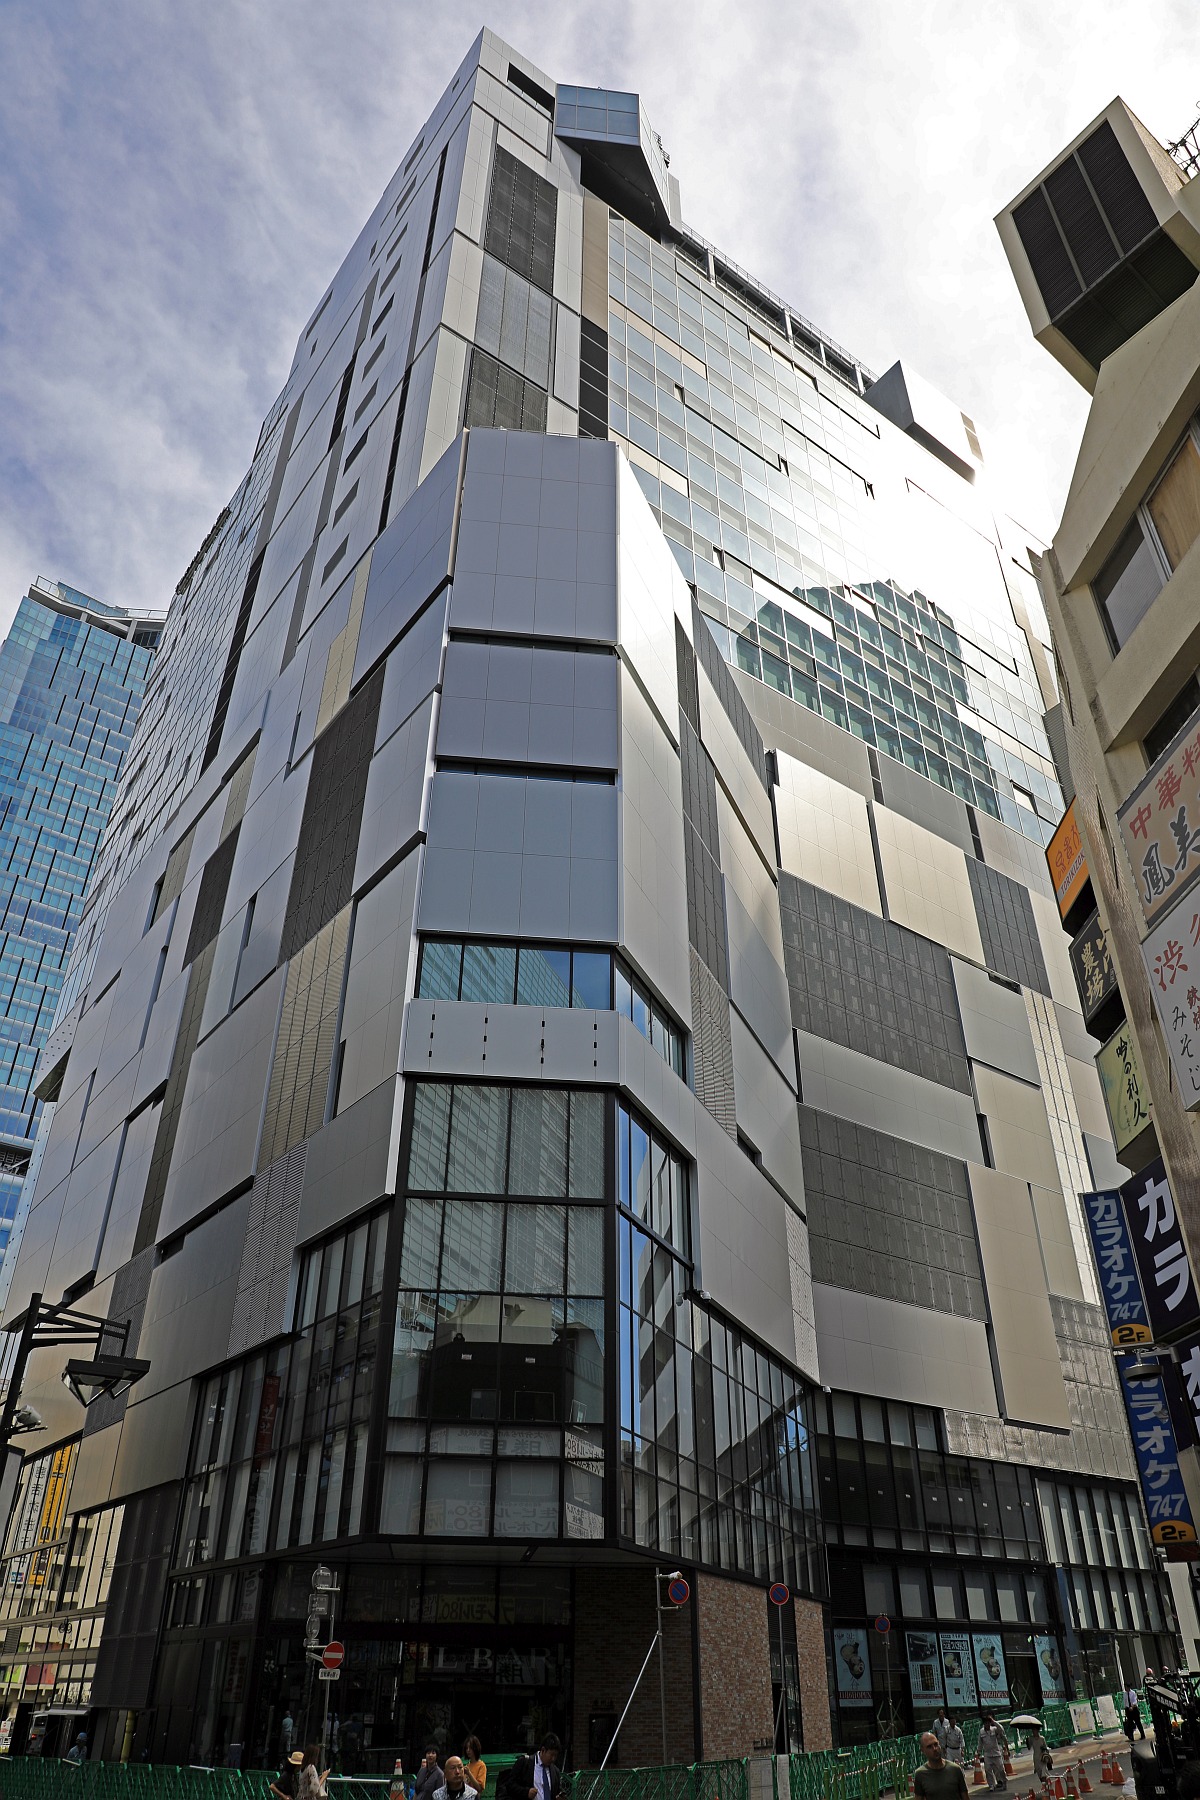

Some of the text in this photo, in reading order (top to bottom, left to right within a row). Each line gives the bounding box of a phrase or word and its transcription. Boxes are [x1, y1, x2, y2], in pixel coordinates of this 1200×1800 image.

[1115, 1035, 1148, 1127] 吟の利久
[1091, 1196, 1136, 1301] カラオケ
[1109, 1300, 1143, 1323] 747
[1117, 1326, 1146, 1344] 2F
[1149, 1493, 1185, 1518] 747
[1160, 1525, 1187, 1541] 2F
